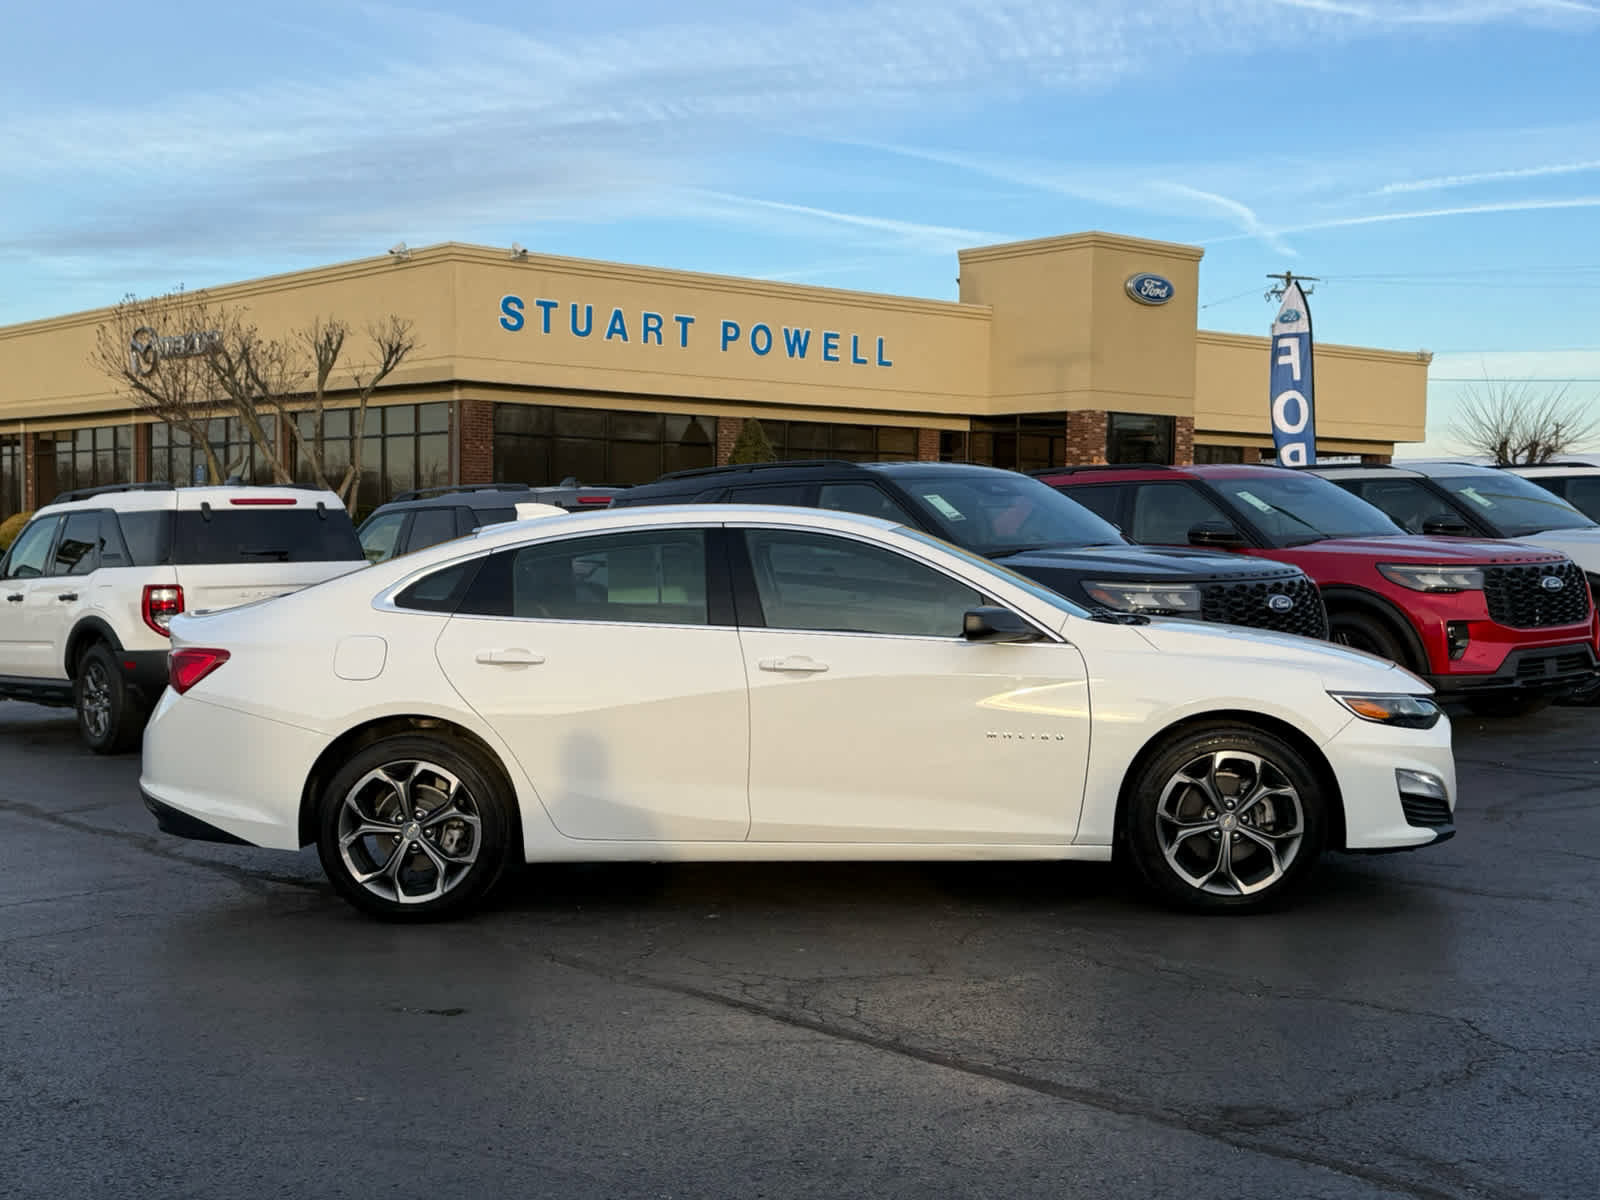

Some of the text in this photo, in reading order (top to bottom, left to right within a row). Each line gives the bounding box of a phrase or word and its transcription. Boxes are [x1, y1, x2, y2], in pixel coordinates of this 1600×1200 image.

[1140, 278, 1169, 298] Ford
[500, 295, 894, 368] STUART POWELL
